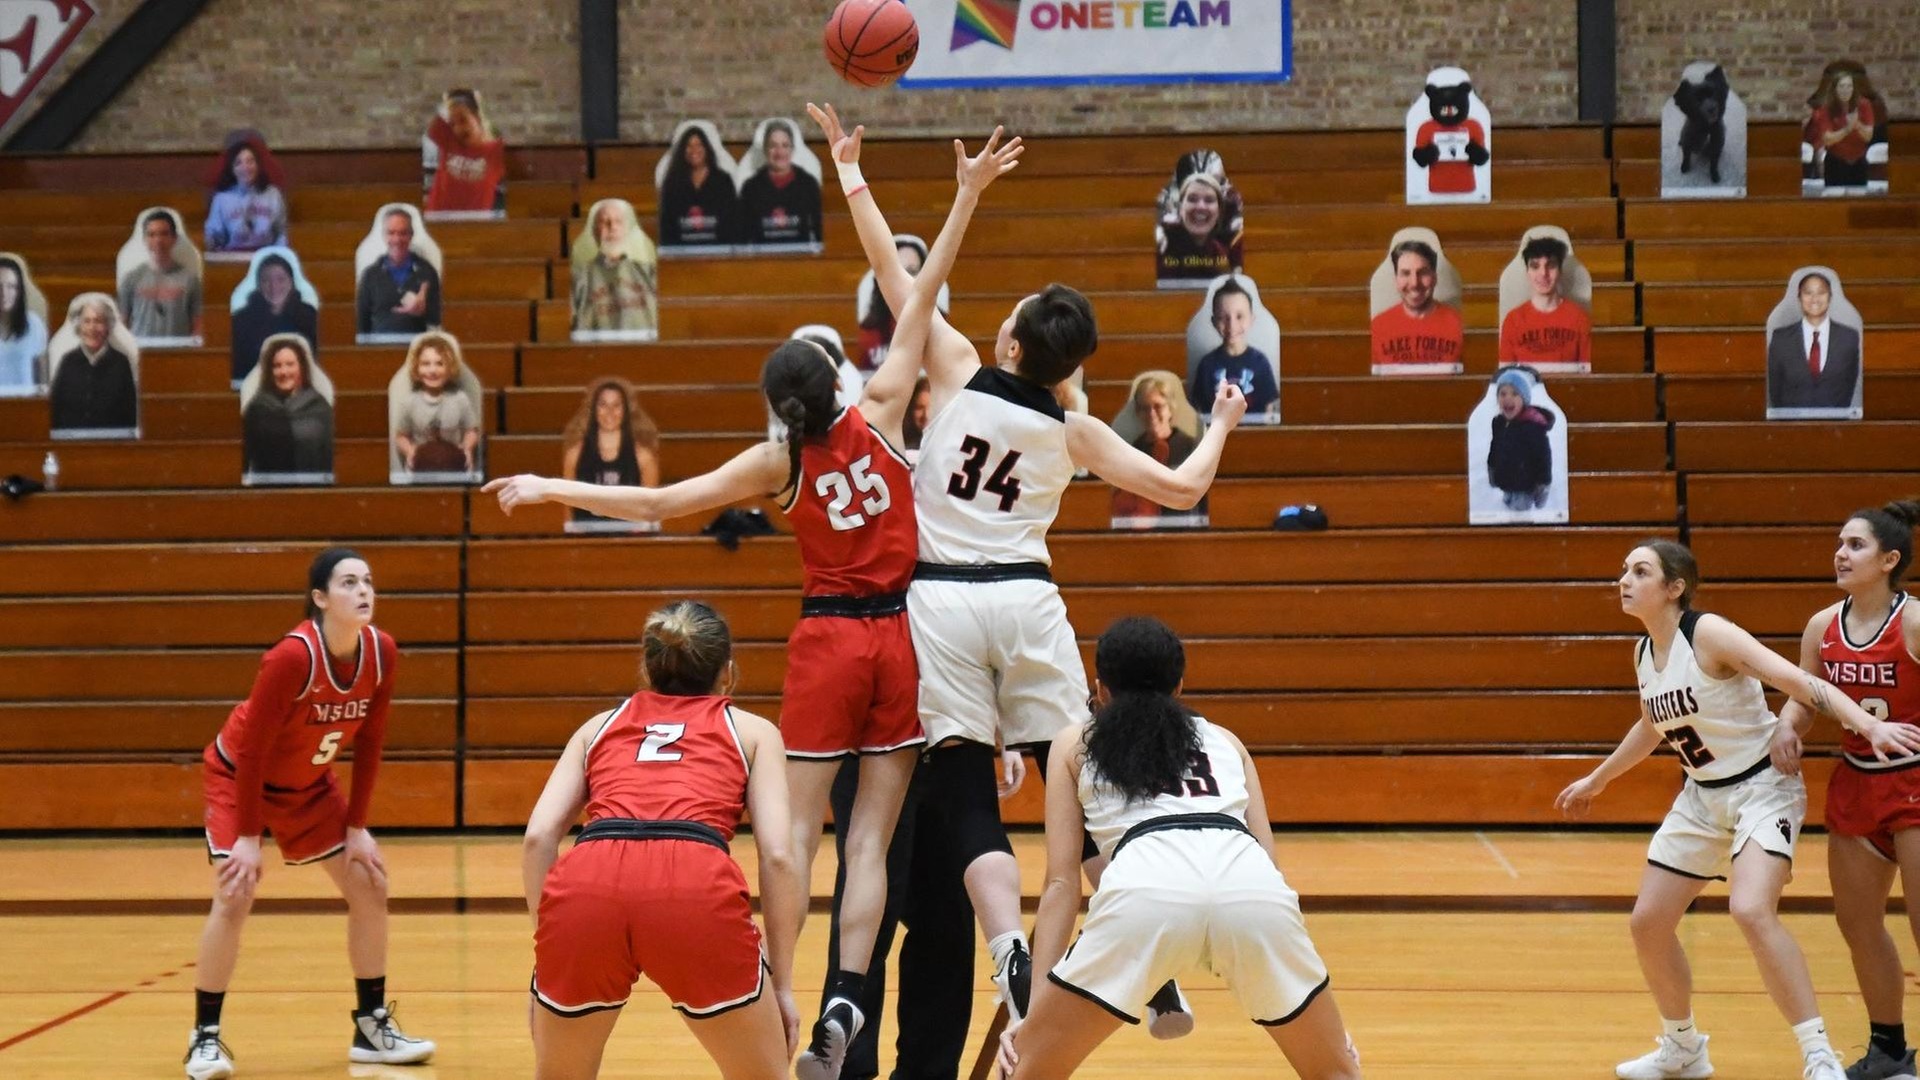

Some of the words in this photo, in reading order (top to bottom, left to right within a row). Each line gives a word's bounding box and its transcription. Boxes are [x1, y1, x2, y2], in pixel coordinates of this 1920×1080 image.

[1030, 0, 1231, 30] ONETEAM
[1183, 254, 1214, 266] Olivia
[1381, 334, 1412, 356] LAKE
[1416, 335, 1458, 356] FOREST
[946, 433, 1023, 513] 34
[815, 454, 892, 532] 25
[1823, 661, 1897, 686] MSOE
[312, 698, 371, 723] MSOE
[311, 730, 344, 766] 5
[634, 722, 687, 763] 2
